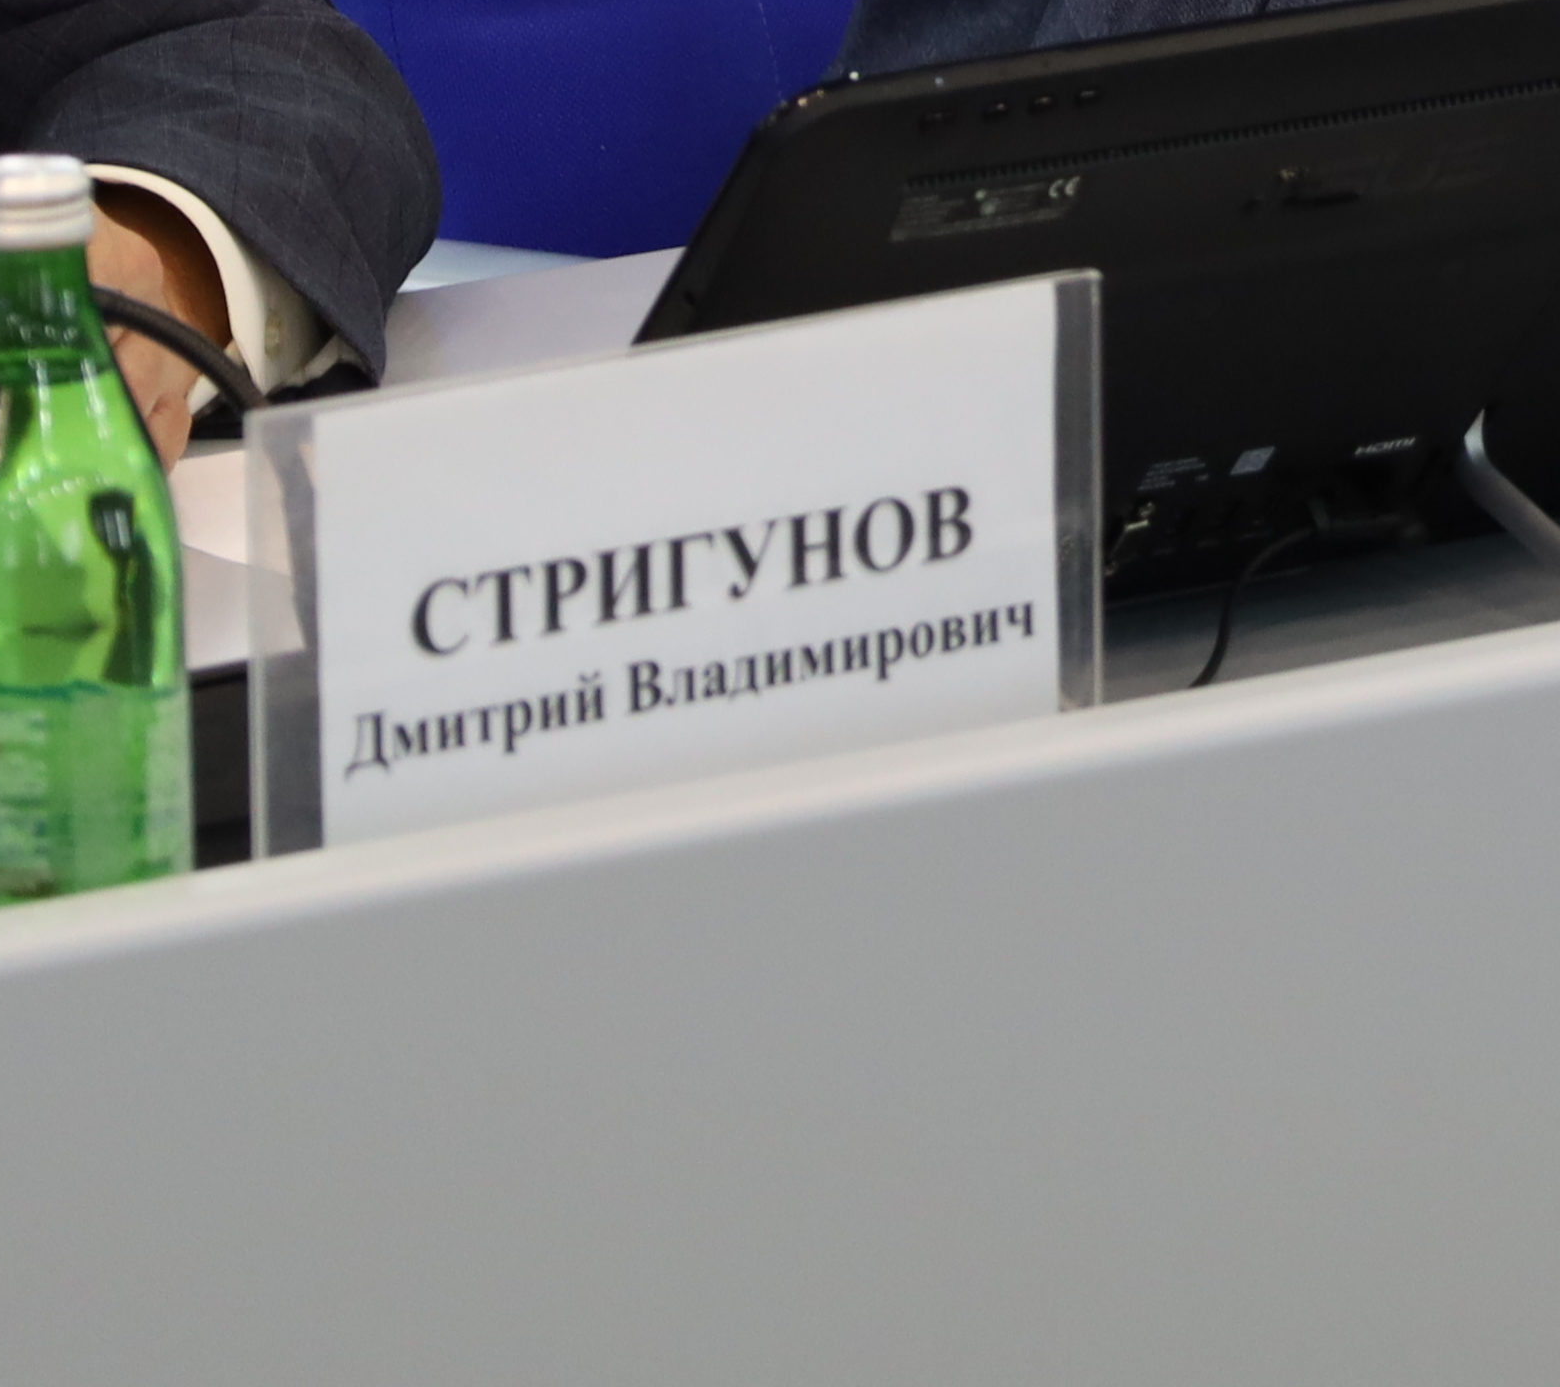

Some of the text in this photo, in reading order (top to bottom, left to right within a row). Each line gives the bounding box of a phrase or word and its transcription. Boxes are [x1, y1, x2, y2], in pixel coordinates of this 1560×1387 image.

[410, 485, 974, 658] СТРИГУНОВ
[344, 601, 1035, 777] Дмитрий Владимирович
